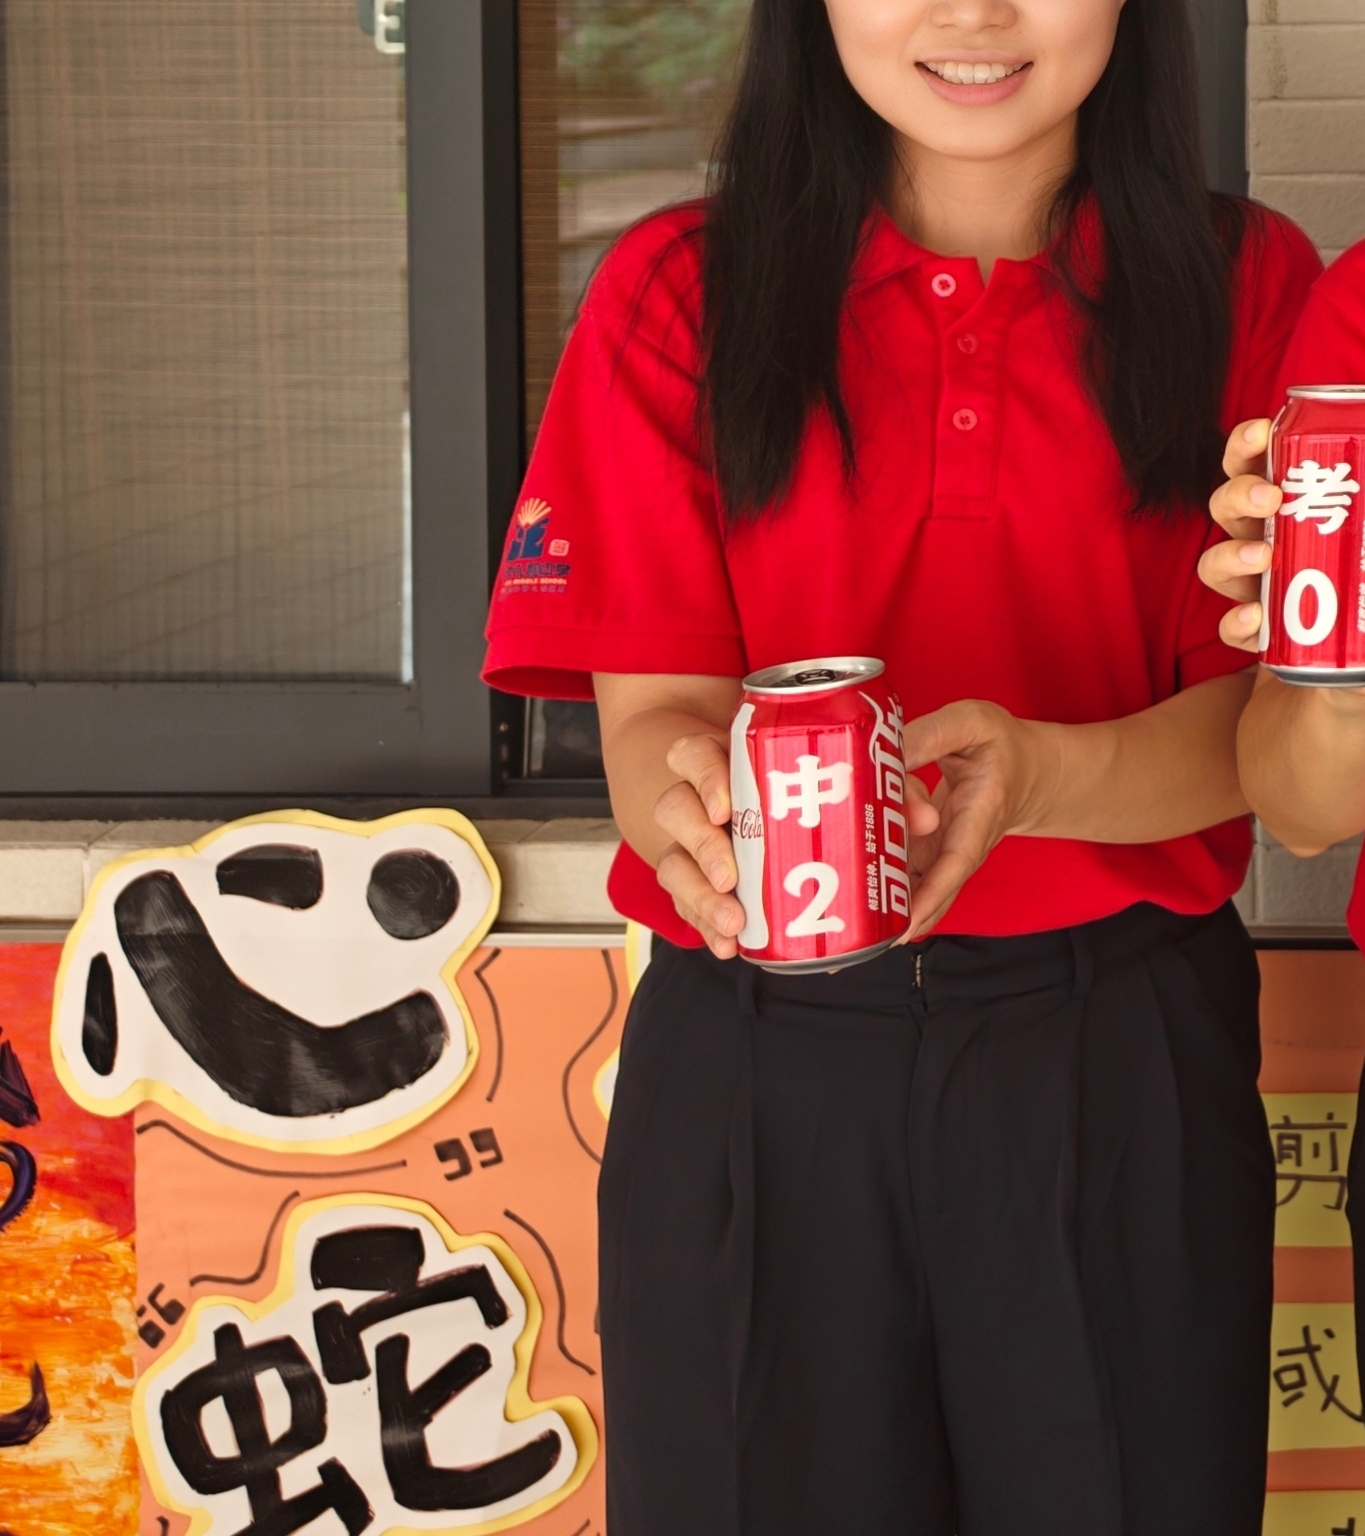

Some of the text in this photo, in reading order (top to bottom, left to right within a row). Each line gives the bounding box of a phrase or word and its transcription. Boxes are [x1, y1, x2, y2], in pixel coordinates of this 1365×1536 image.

[1278, 459, 1361, 535] 考
[1283, 568, 1338, 646] 0
[766, 754, 854, 828] 中
[783, 861, 846, 938] 2
[81, 842, 462, 1117] 心
[1270, 1112, 1348, 1210] 剪
[161, 1225, 562, 1536] 蛇
